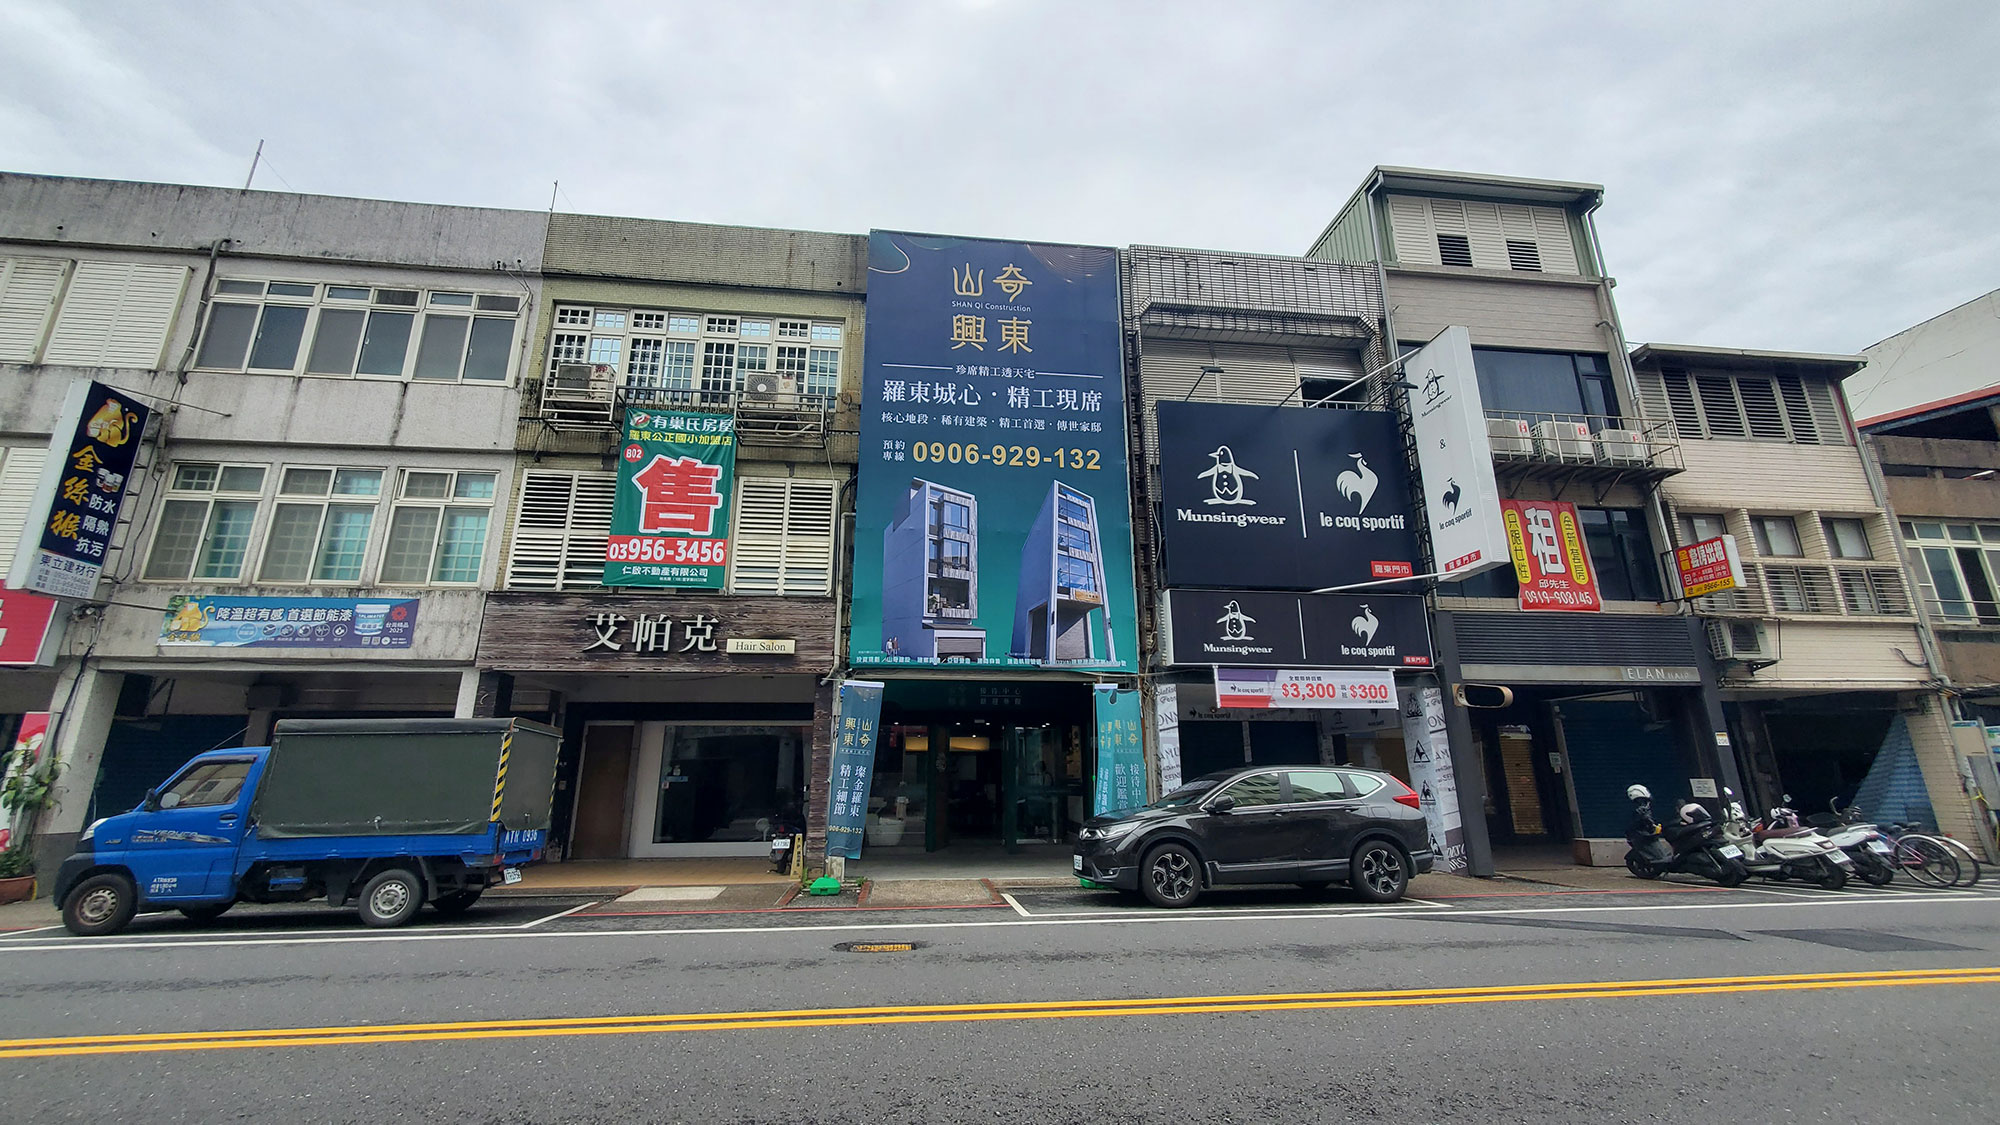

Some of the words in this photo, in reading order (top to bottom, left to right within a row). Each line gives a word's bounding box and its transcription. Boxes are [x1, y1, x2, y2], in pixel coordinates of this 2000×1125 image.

[952, 300, 973, 309] SHAN
[985, 302, 1031, 313] Construction
[951, 314, 1033, 354] 興東
[955, 364, 1036, 380] 珍席精工透天宅
[1420, 395, 1452, 418] Munsingwear
[652, 415, 734, 432] 有巢氏房屋
[628, 430, 732, 446] 羅東公正國小加盟店
[883, 440, 905, 451] 預約
[1439, 439, 1446, 450] &
[883, 451, 905, 462] 專線
[913, 441, 1102, 470] 0906-929-132
[50, 445, 103, 540] 金絲猴
[632, 454, 722, 535] 售
[88, 493, 117, 515] 防水
[82, 514, 110, 536] 隔熱
[1177, 509, 1286, 527] Munsingwear
[1320, 512, 1333, 527] le
[1336, 515, 1360, 530] coq
[1362, 514, 1405, 532] sportif
[1439, 521, 1445, 530] le
[1445, 517, 1455, 529] coq
[1455, 509, 1472, 526] sportif
[75, 537, 105, 557] 抗污
[1524, 507, 1565, 576] 租
[40, 554, 97, 579] 東立建材行
[1374, 564, 1409, 574] 羅東門市
[1539, 579, 1570, 589] 邱先生
[1525, 590, 1593, 605] 0919-903145
[287, 608, 353, 622] 首選節能漆
[583, 613, 720, 653] 艾帕克
[735, 641, 758, 651] Hair
[759, 641, 786, 651] Salon
[1203, 643, 1273, 656] Munsingwear
[1341, 645, 1349, 656] le
[1350, 647, 1366, 657] coq
[1367, 646, 1395, 658] sportif
[1627, 668, 1666, 680] ELAN
[1282, 683, 1336, 700] $3,300
[1349, 684, 1388, 699] $300
[843, 717, 857, 746] 興東
[833, 763, 852, 816] 精工細節
